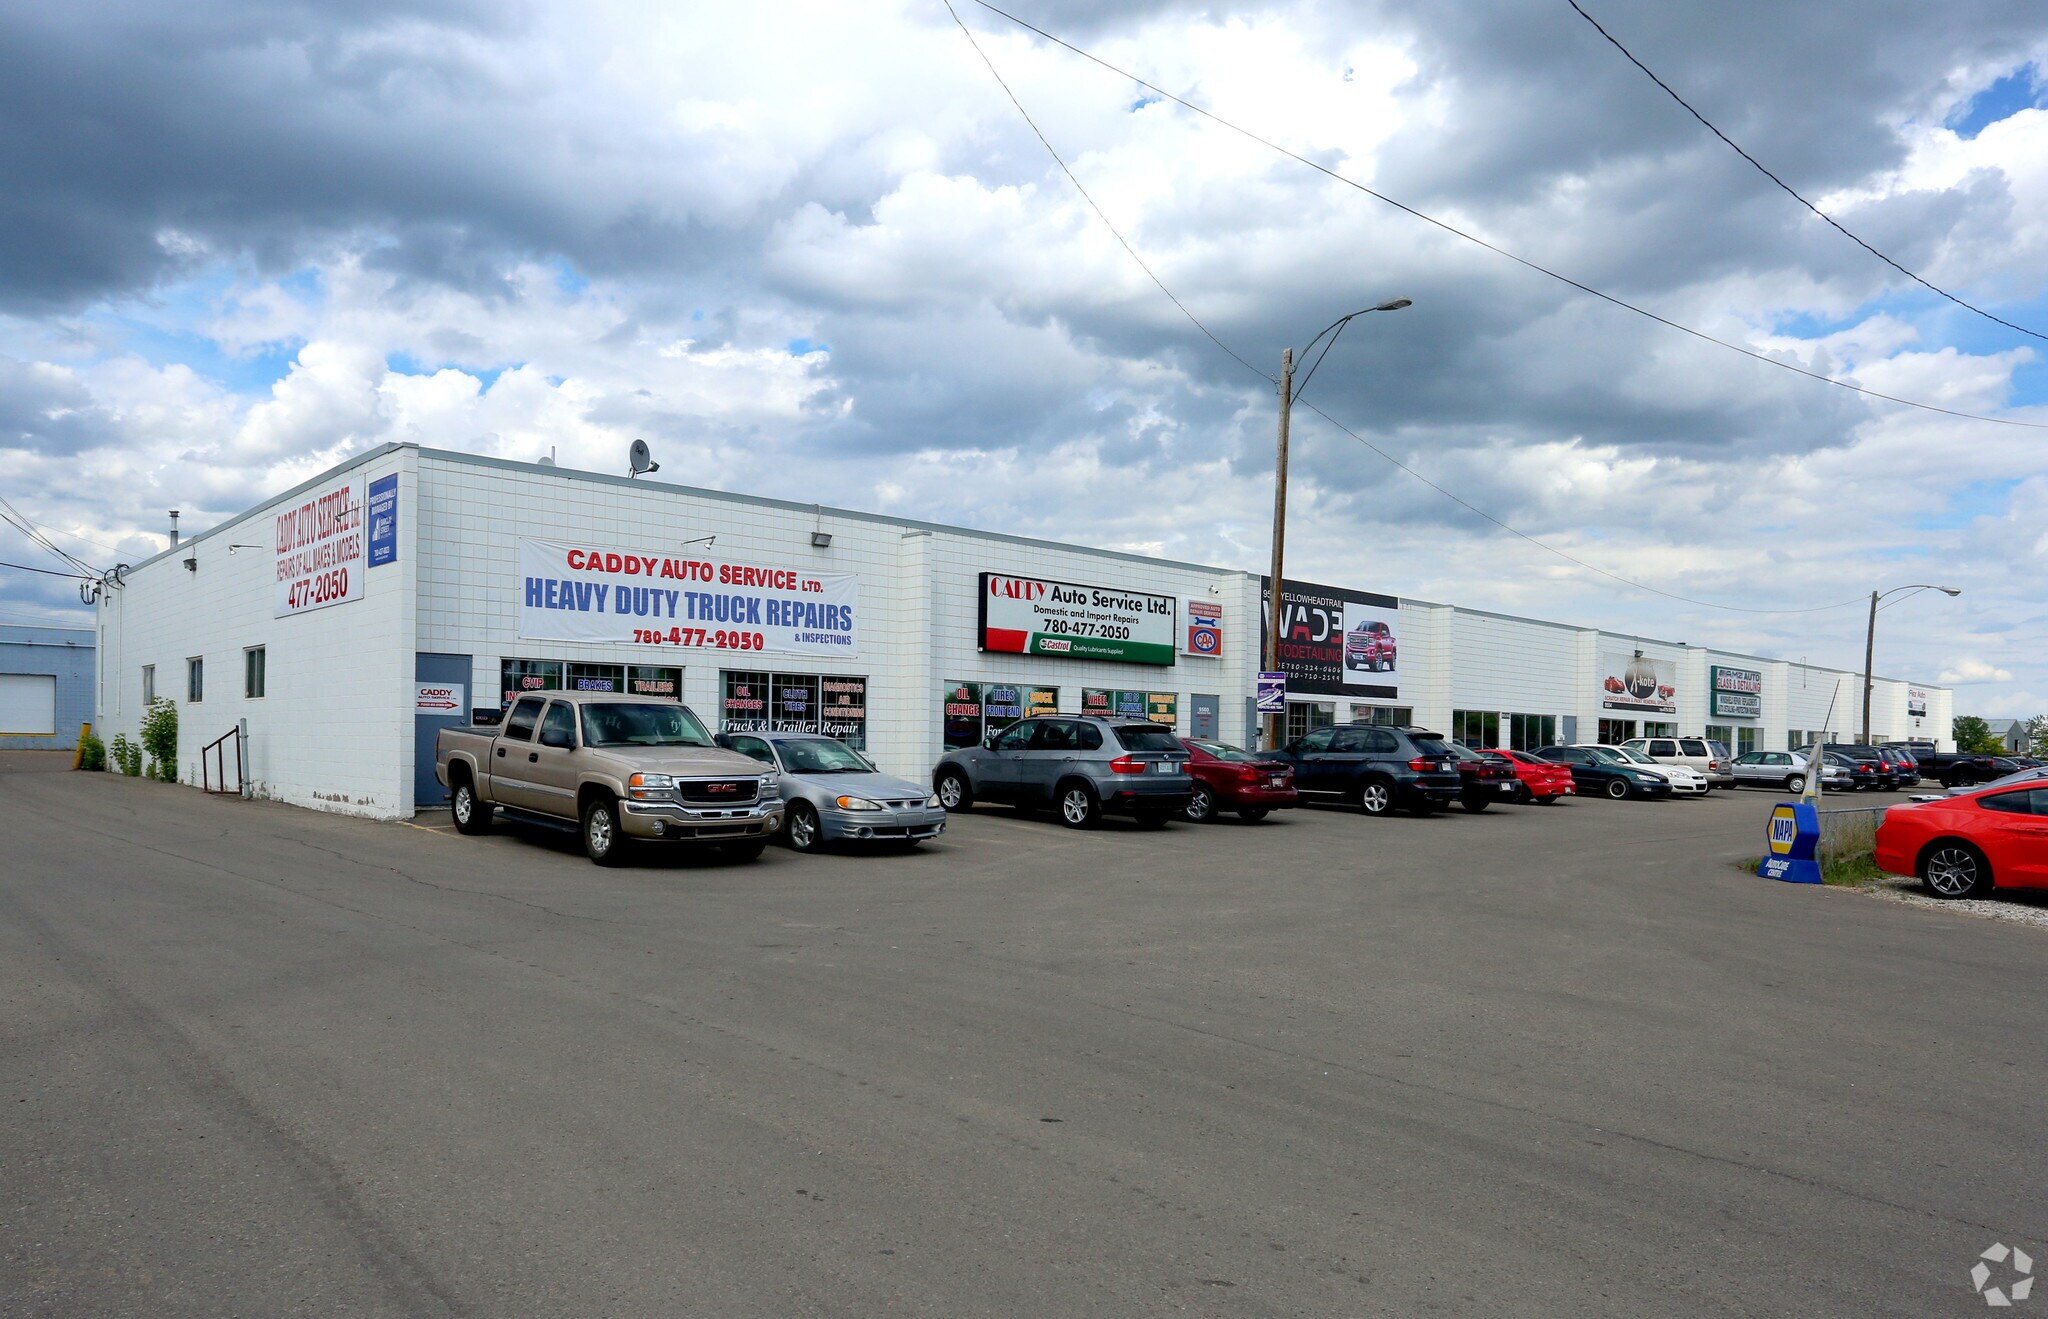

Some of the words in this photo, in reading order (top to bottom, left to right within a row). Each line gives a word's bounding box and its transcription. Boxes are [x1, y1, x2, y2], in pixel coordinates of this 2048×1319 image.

[277, 509, 297, 556] CADDY
[297, 501, 316, 547] AUTO
[318, 486, 350, 541] SERVICE
[277, 556, 295, 582] REPAIRS
[295, 554, 302, 576] OF
[303, 552, 312, 574] ALL
[313, 544, 331, 572] MAKES
[332, 542, 336, 565] &
[337, 533, 360, 564] MODELS
[567, 549, 658, 577] CADDY
[661, 558, 714, 582] AUTO
[719, 564, 797, 590] SERVICE
[801, 579, 823, 593] LTD.
[288, 567, 348, 609] 477-2050
[990, 576, 1047, 601] CADDY
[1051, 585, 1087, 605] Auto
[1092, 590, 1143, 612] Service
[1147, 597, 1171, 616] Ltd.
[525, 577, 609, 613] HEAVY
[615, 585, 679, 618] DUTY
[684, 591, 761, 624] TRUCK
[767, 598, 852, 632] REPAIRS
[1034, 605, 1068, 617] Domestic
[1070, 608, 1085, 619] and
[1087, 610, 1111, 622] Import
[1113, 613, 1140, 626] Repairs
[1043, 618, 1130, 640] 780-477-2050
[633, 628, 764, 651] 780-477-2050
[795, 633, 801, 642] &
[802, 632, 852, 646] INSPECTIONS
[1047, 640, 1069, 651] Castrol
[1197, 633, 1213, 648] CAA
[1073, 645, 1088, 653] Quality
[1088, 646, 1107, 654] Lubricants
[522, 677, 544, 689] CVIP
[1744, 672, 1760, 681] AUTO
[578, 679, 613, 692] BRAKES
[634, 680, 674, 693] TRAILERS
[736, 686, 750, 697] OIL
[824, 682, 864, 694] DIAGNOSTICS
[1718, 678, 1732, 689] GLASS
[1737, 680, 1760, 692] DETAILING
[421, 688, 453, 696] CADDY
[782, 688, 808, 700] CLUTH
[956, 688, 970, 700] OIL
[993, 689, 1015, 701] TIRES
[724, 699, 763, 710] CHANGES
[784, 701, 806, 712] TIRES
[838, 695, 850, 705] AIR
[1087, 694, 1108, 706] WHEEL
[946, 703, 980, 716] CHANGE
[986, 704, 1007, 717] FRONT
[1007, 706, 1020, 718] END
[721, 719, 755, 732] Truck
[757, 721, 768, 732] &
[776, 720, 817, 733] Trailler
[822, 721, 858, 736] Repair
[708, 784, 737, 792] GMC
[1773, 819, 1793, 842] NAPA
